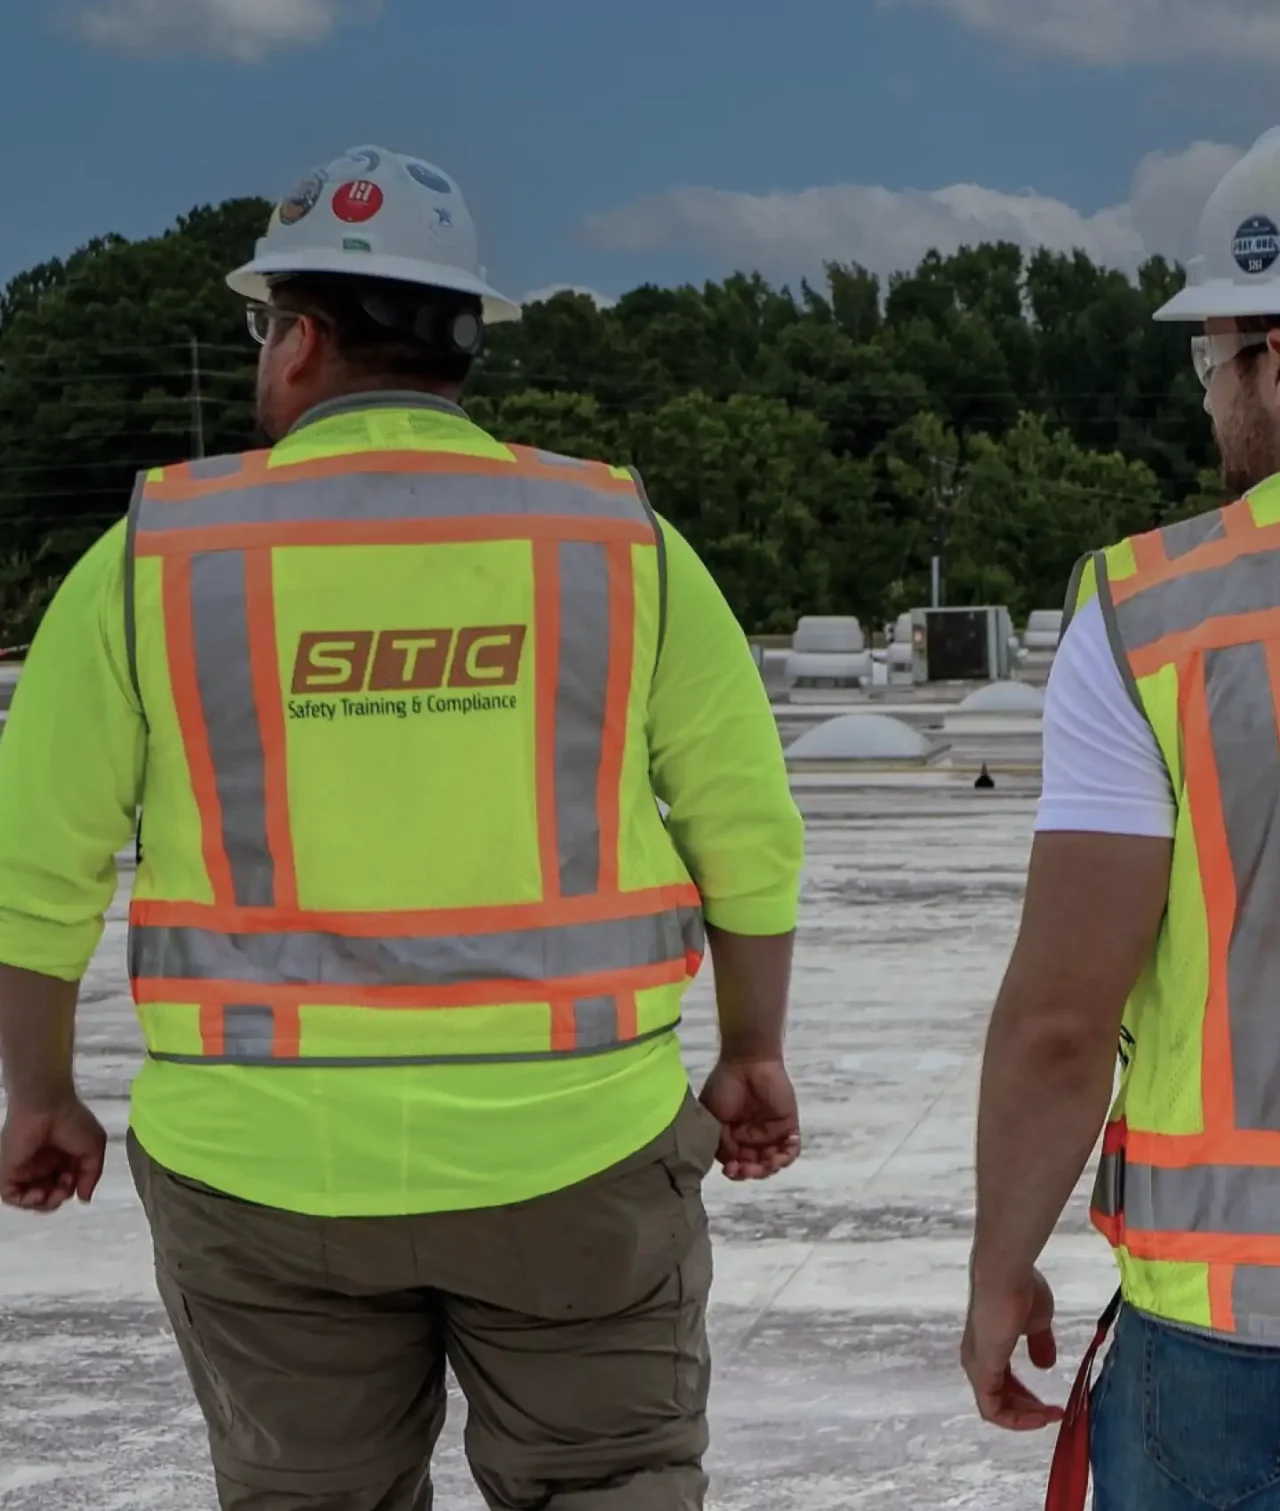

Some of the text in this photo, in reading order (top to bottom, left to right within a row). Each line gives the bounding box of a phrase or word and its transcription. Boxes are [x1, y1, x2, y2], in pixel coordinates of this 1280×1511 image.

[304, 632, 514, 687] STC
[288, 692, 517, 721] Safety Training & Compliance
